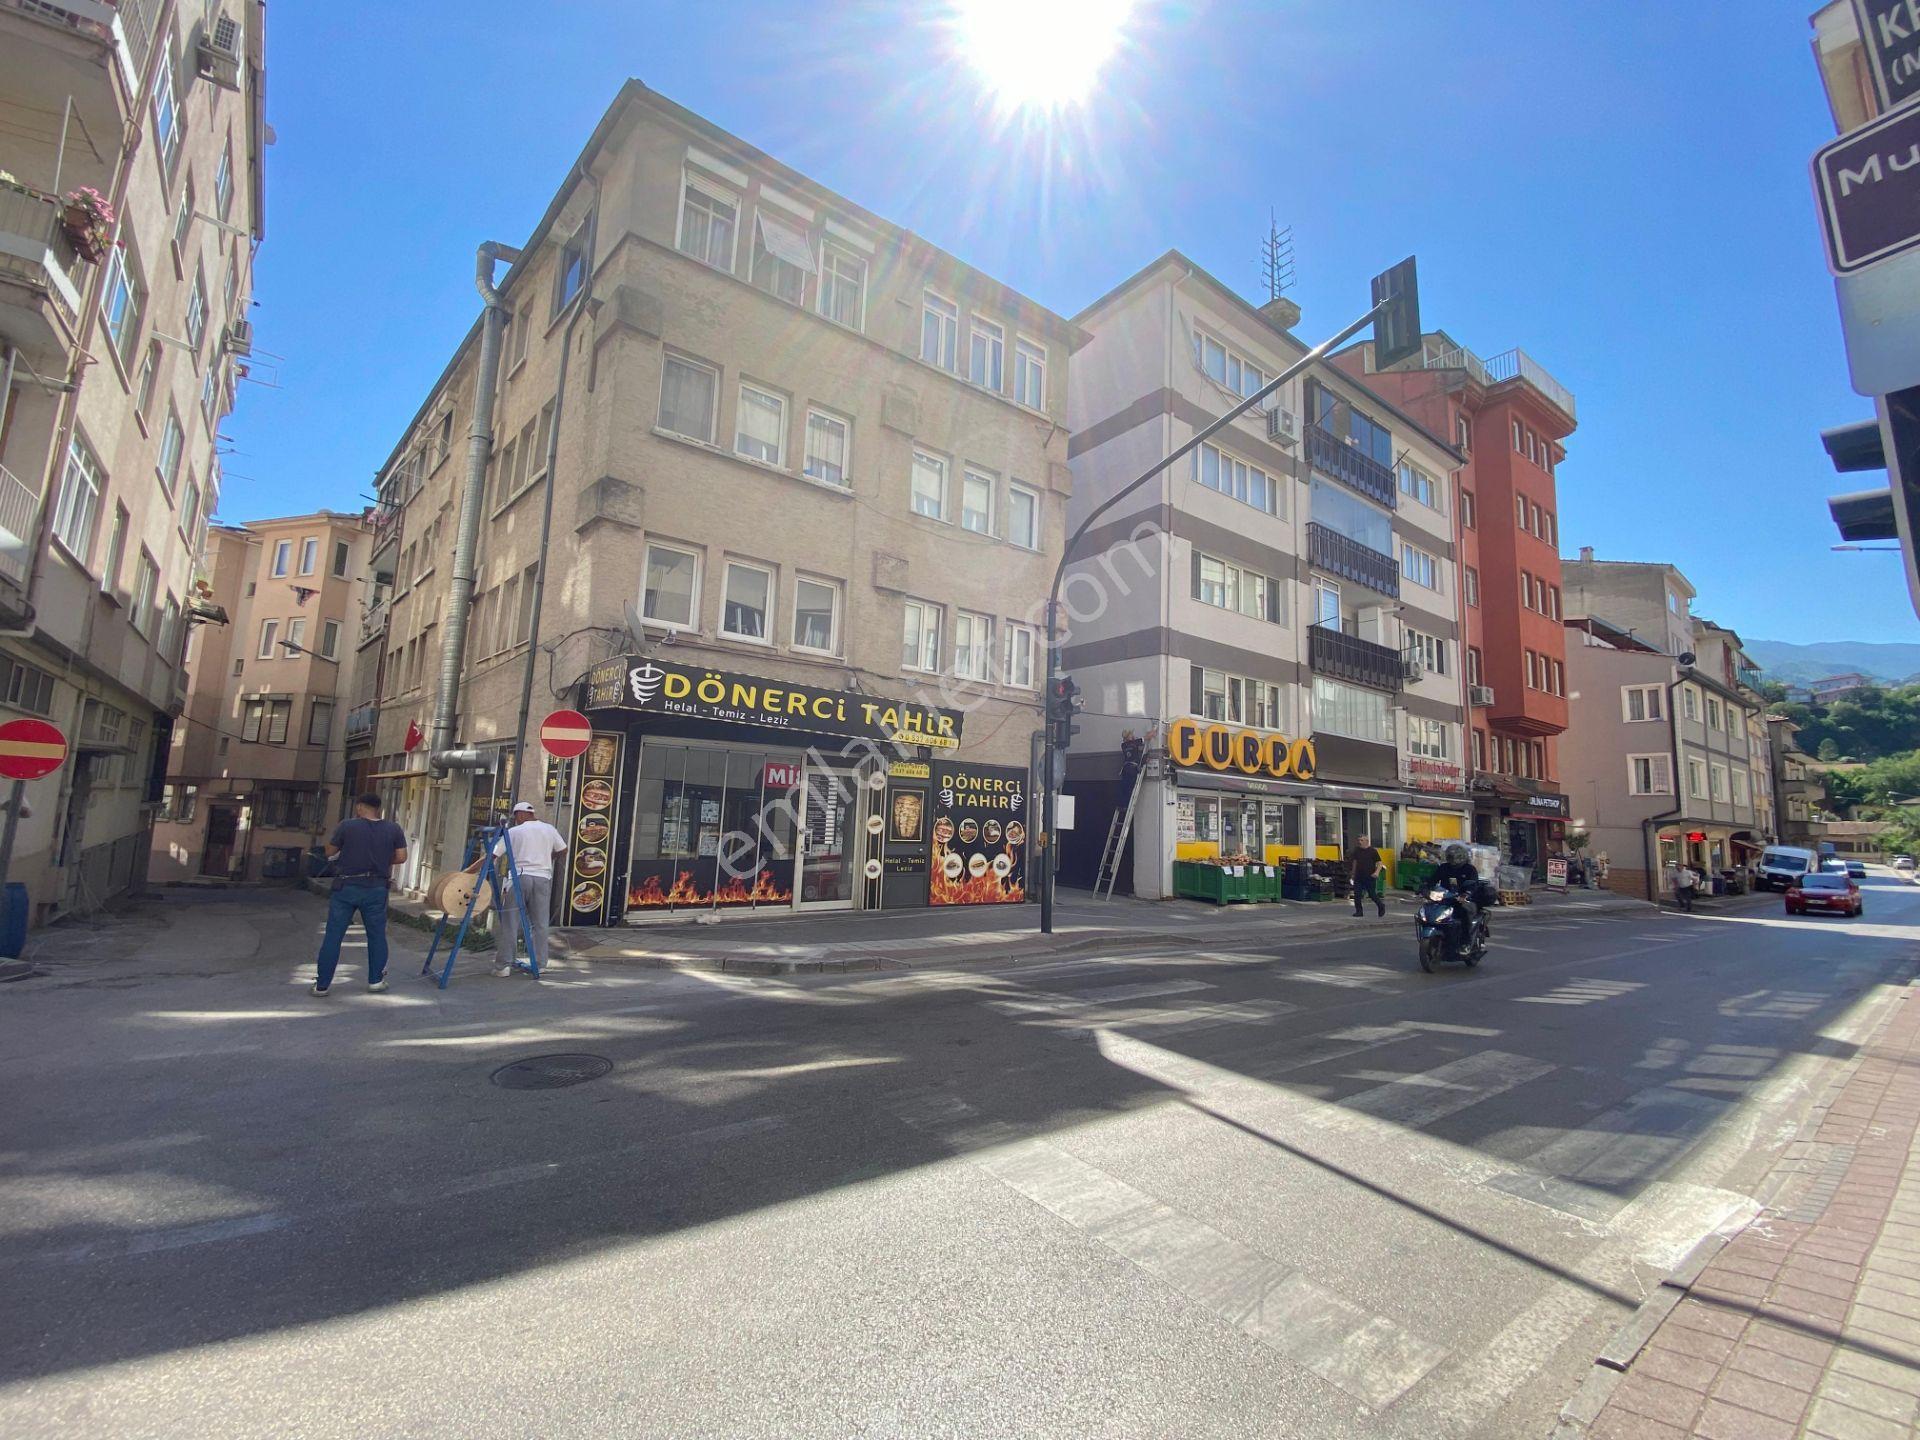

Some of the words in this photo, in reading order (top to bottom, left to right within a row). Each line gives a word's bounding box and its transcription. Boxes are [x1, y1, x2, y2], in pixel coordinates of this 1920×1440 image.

[664, 700, 697, 714] Helal
[712, 706, 746, 720] Temiz
[760, 713, 789, 726] Leziz
[1181, 726, 1314, 774] FURPA
